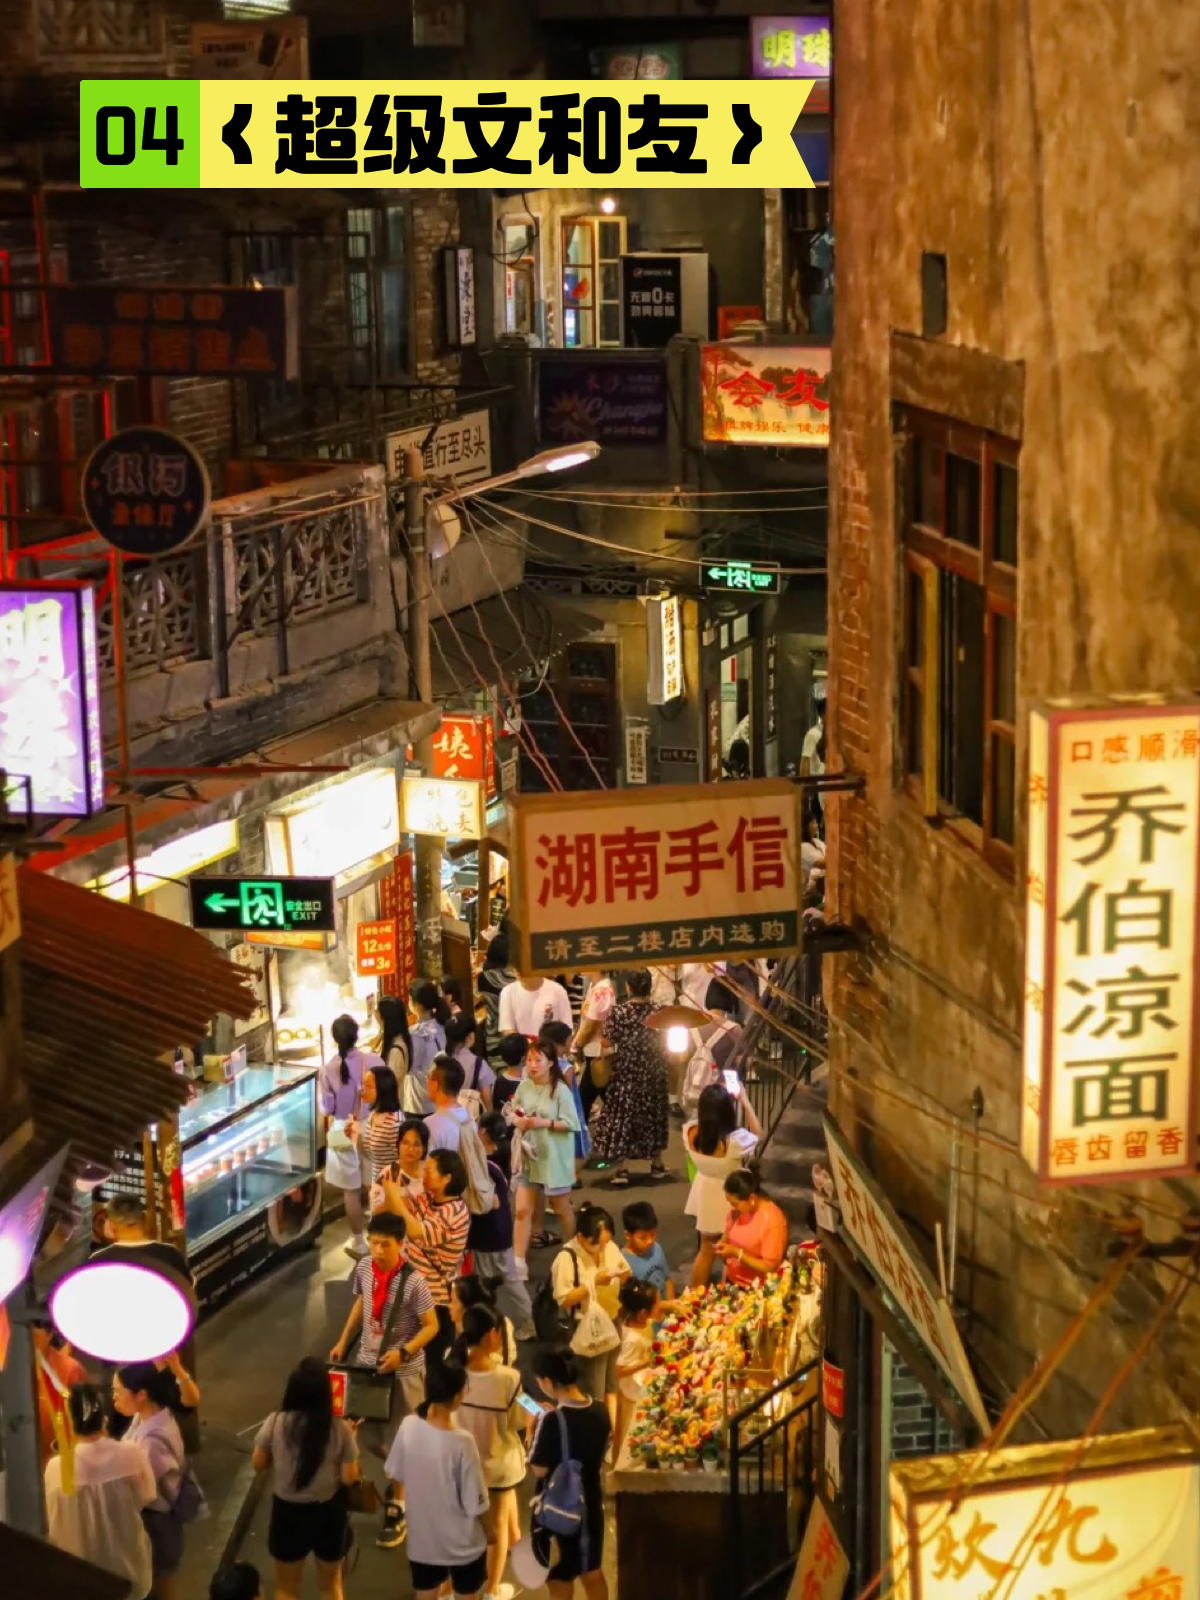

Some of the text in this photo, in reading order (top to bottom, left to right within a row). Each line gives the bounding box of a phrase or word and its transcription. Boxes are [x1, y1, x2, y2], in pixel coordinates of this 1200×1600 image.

[719, 369, 829, 412] 会友
[394, 425, 486, 478] 电直行至尽头
[1071, 729, 1200, 764] 口感顺滑
[535, 815, 788, 908] 湖南手信
[292, 911, 317, 921] EXIT
[545, 919, 786, 962] 请至二楼店内选购
[1061, 783, 1187, 1128] 乔伯凉面
[1051, 1127, 1184, 1167] 唇齿留香
